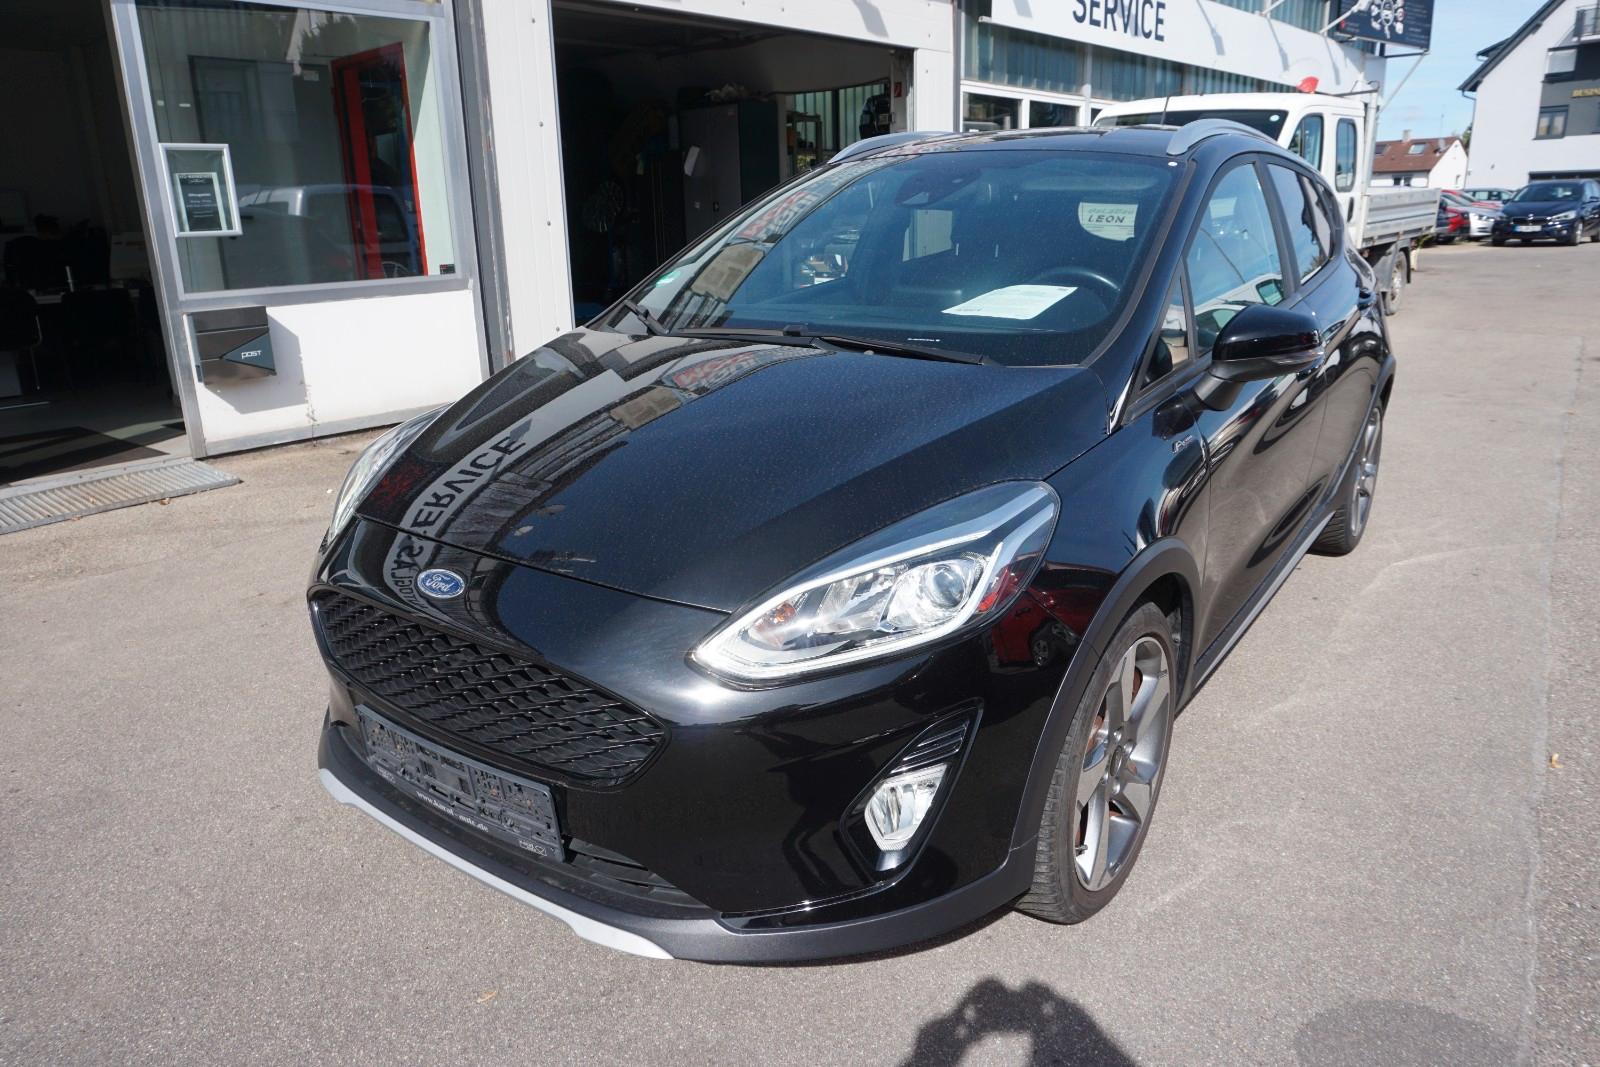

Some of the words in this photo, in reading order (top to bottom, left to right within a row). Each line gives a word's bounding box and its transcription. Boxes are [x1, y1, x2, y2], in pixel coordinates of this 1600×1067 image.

[1072, 0, 1166, 42] SERVICE
[1087, 214, 1126, 224] LEON
[425, 573, 455, 592] Ford
